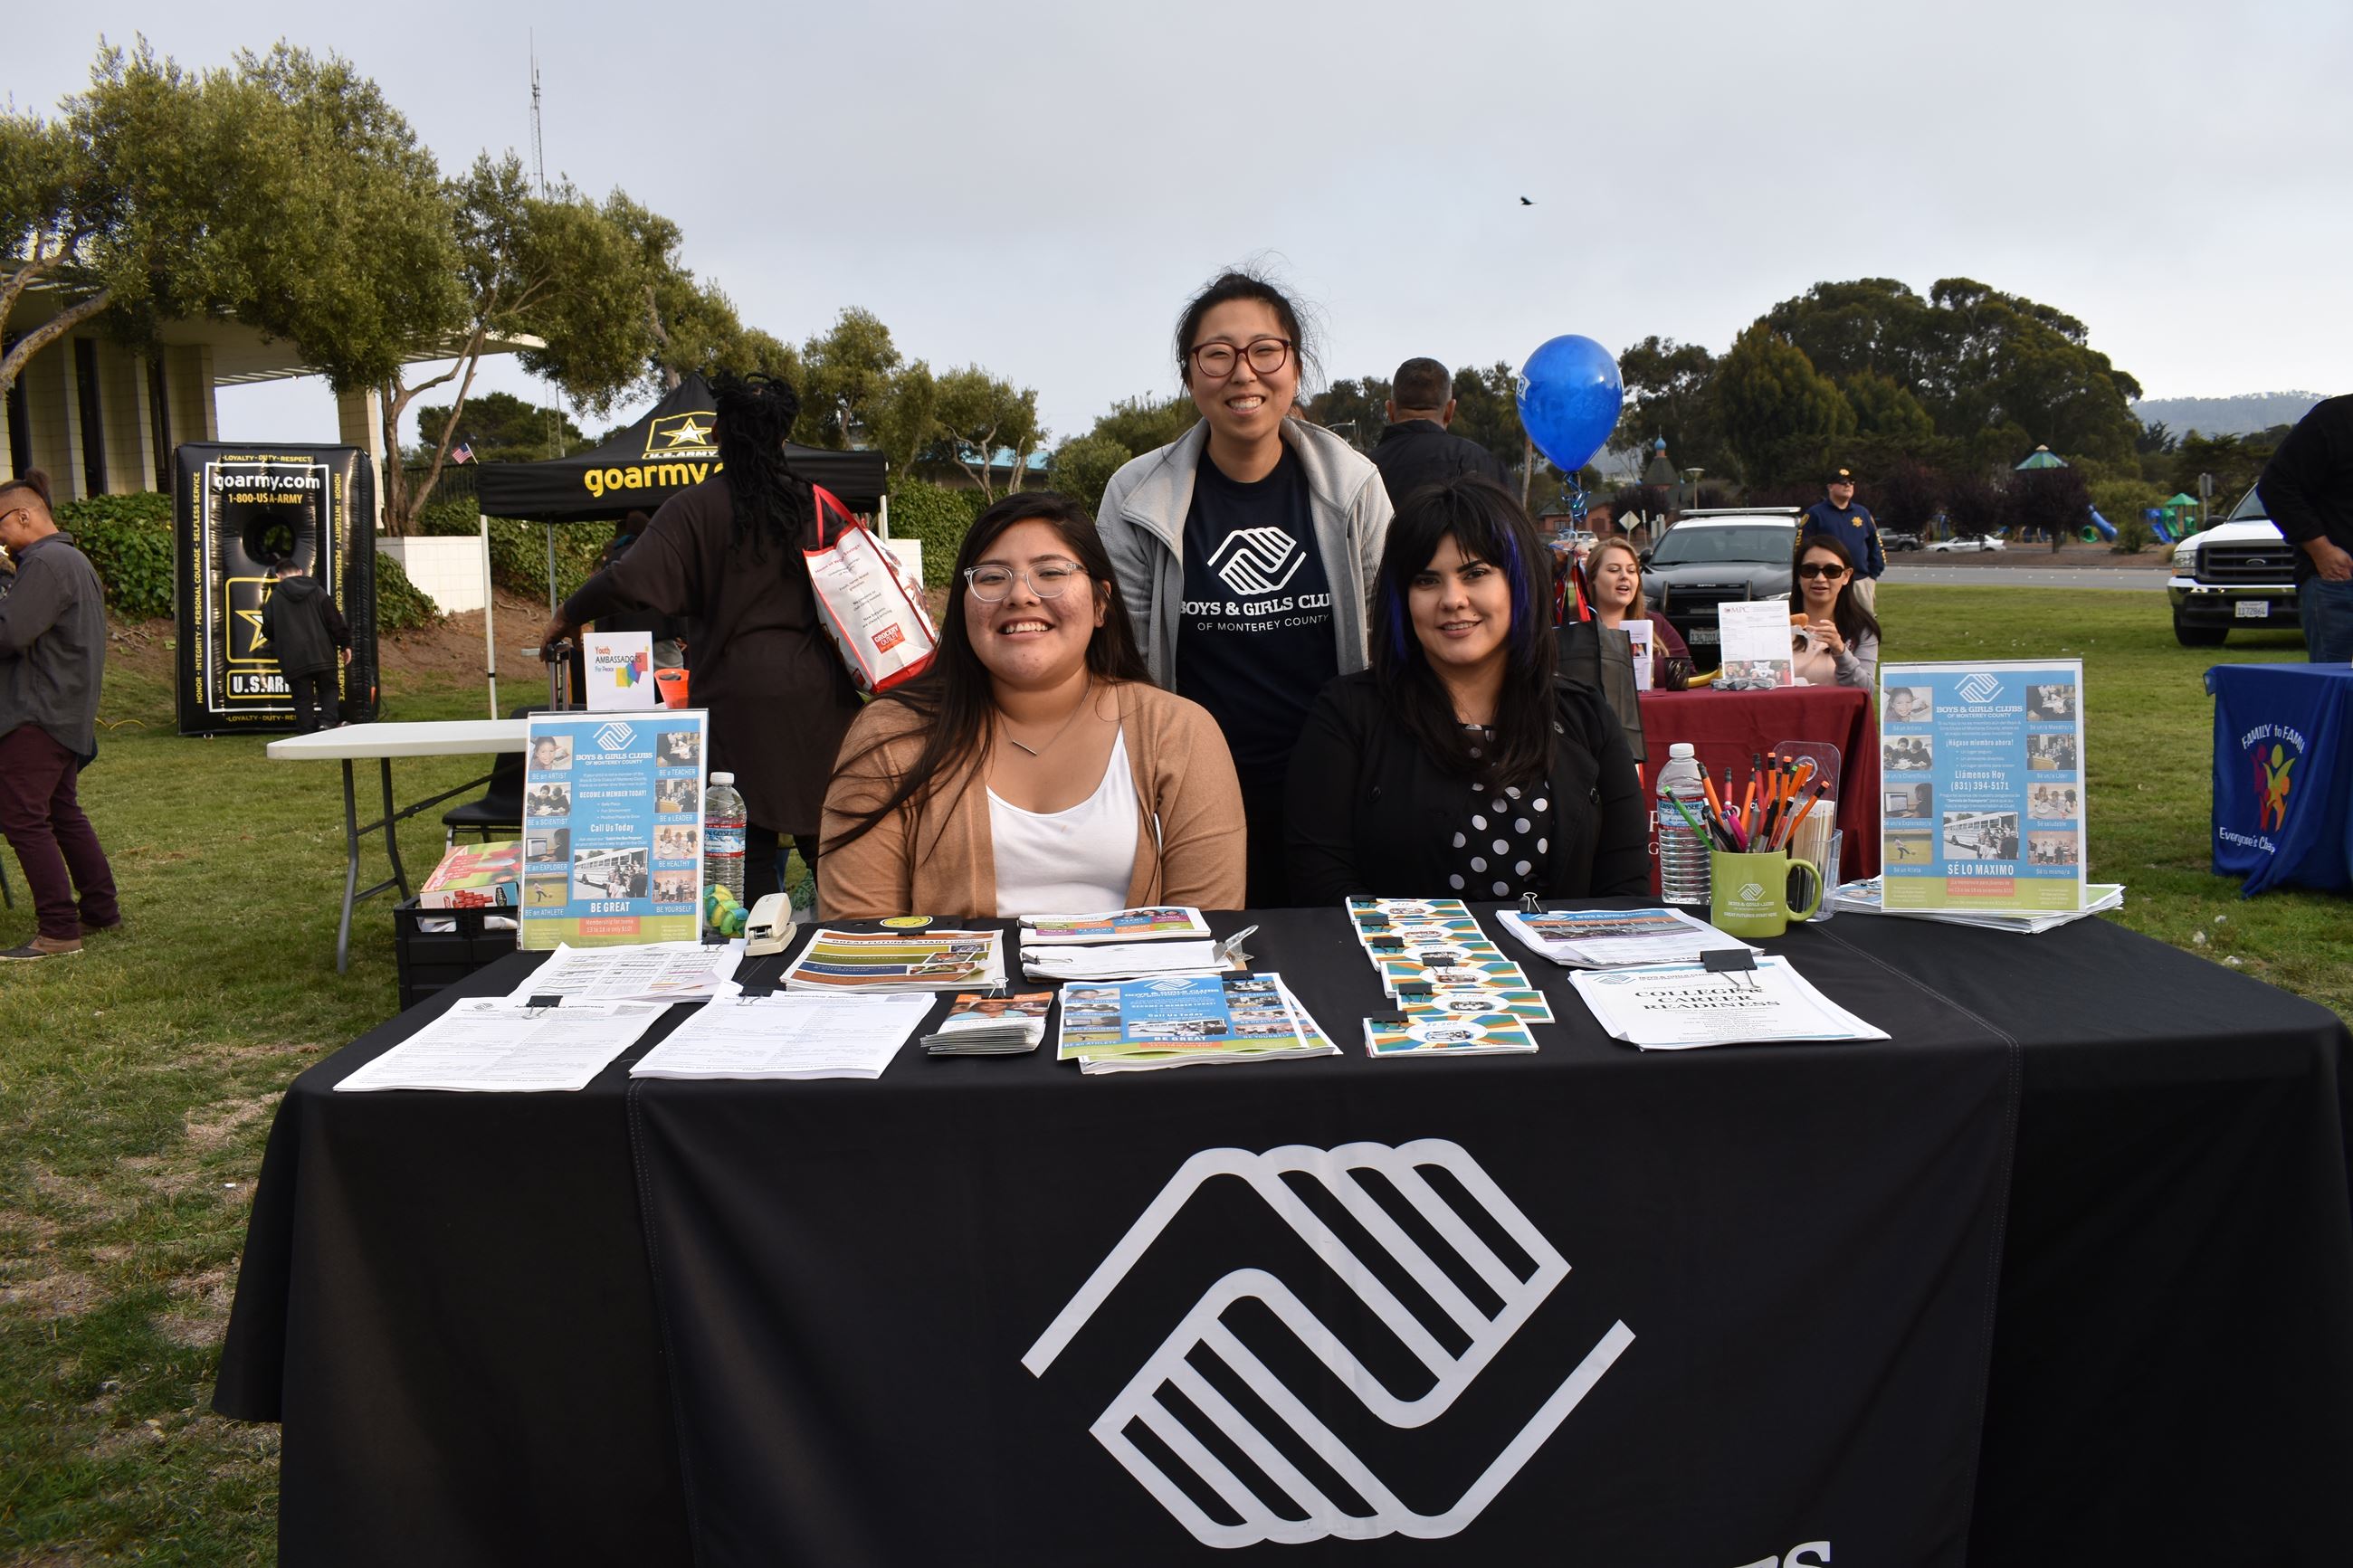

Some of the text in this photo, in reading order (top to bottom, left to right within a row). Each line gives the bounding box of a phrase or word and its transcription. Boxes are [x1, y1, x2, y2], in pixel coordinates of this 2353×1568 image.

[214, 474, 320, 491] goarmy.com
[584, 462, 723, 498] goarmy
[228, 493, 303, 504] 1-800-USA-ARMY
[334, 506, 342, 545] INTEGRITY
[194, 547, 202, 584] COURAGE
[335, 549, 343, 588] PERSONAL
[194, 584, 202, 625] PERSONAL
[1224, 602, 1241, 616] &
[1243, 597, 1294, 616] GIRLS
[1298, 593, 1332, 609] CLU
[1197, 614, 1330, 632] OF MONTEREY COUNTY
[195, 631, 203, 670] INTEGRITY
[595, 646, 611, 655] Youth
[595, 655, 642, 664] AMBASSADORS
[195, 676, 204, 704] HONOR
[233, 675, 291, 694] U.S.AR
[1995, 705, 2023, 713] CLUBS
[2241, 723, 2272, 750] FAMILY
[2274, 724, 2282, 738] to
[1991, 770, 2005, 781] Hoy
[629, 789, 647, 797] TODAY!
[1950, 781, 2009, 792] (831) 394-5171
[590, 824, 605, 832] Call
[615, 823, 634, 832] Today
[2219, 826, 2258, 848] Everyone's
[540, 863, 567, 871] EXPLORER
[1948, 861, 2014, 876] SÉ LO MAXIMO
[591, 901, 631, 913] BE GREAT
[665, 905, 692, 913] YOURSELF
[1634, 987, 1744, 997] COLLEGE
[1657, 995, 1754, 1003] CAREER
[1643, 1001, 1781, 1011] READINESS
